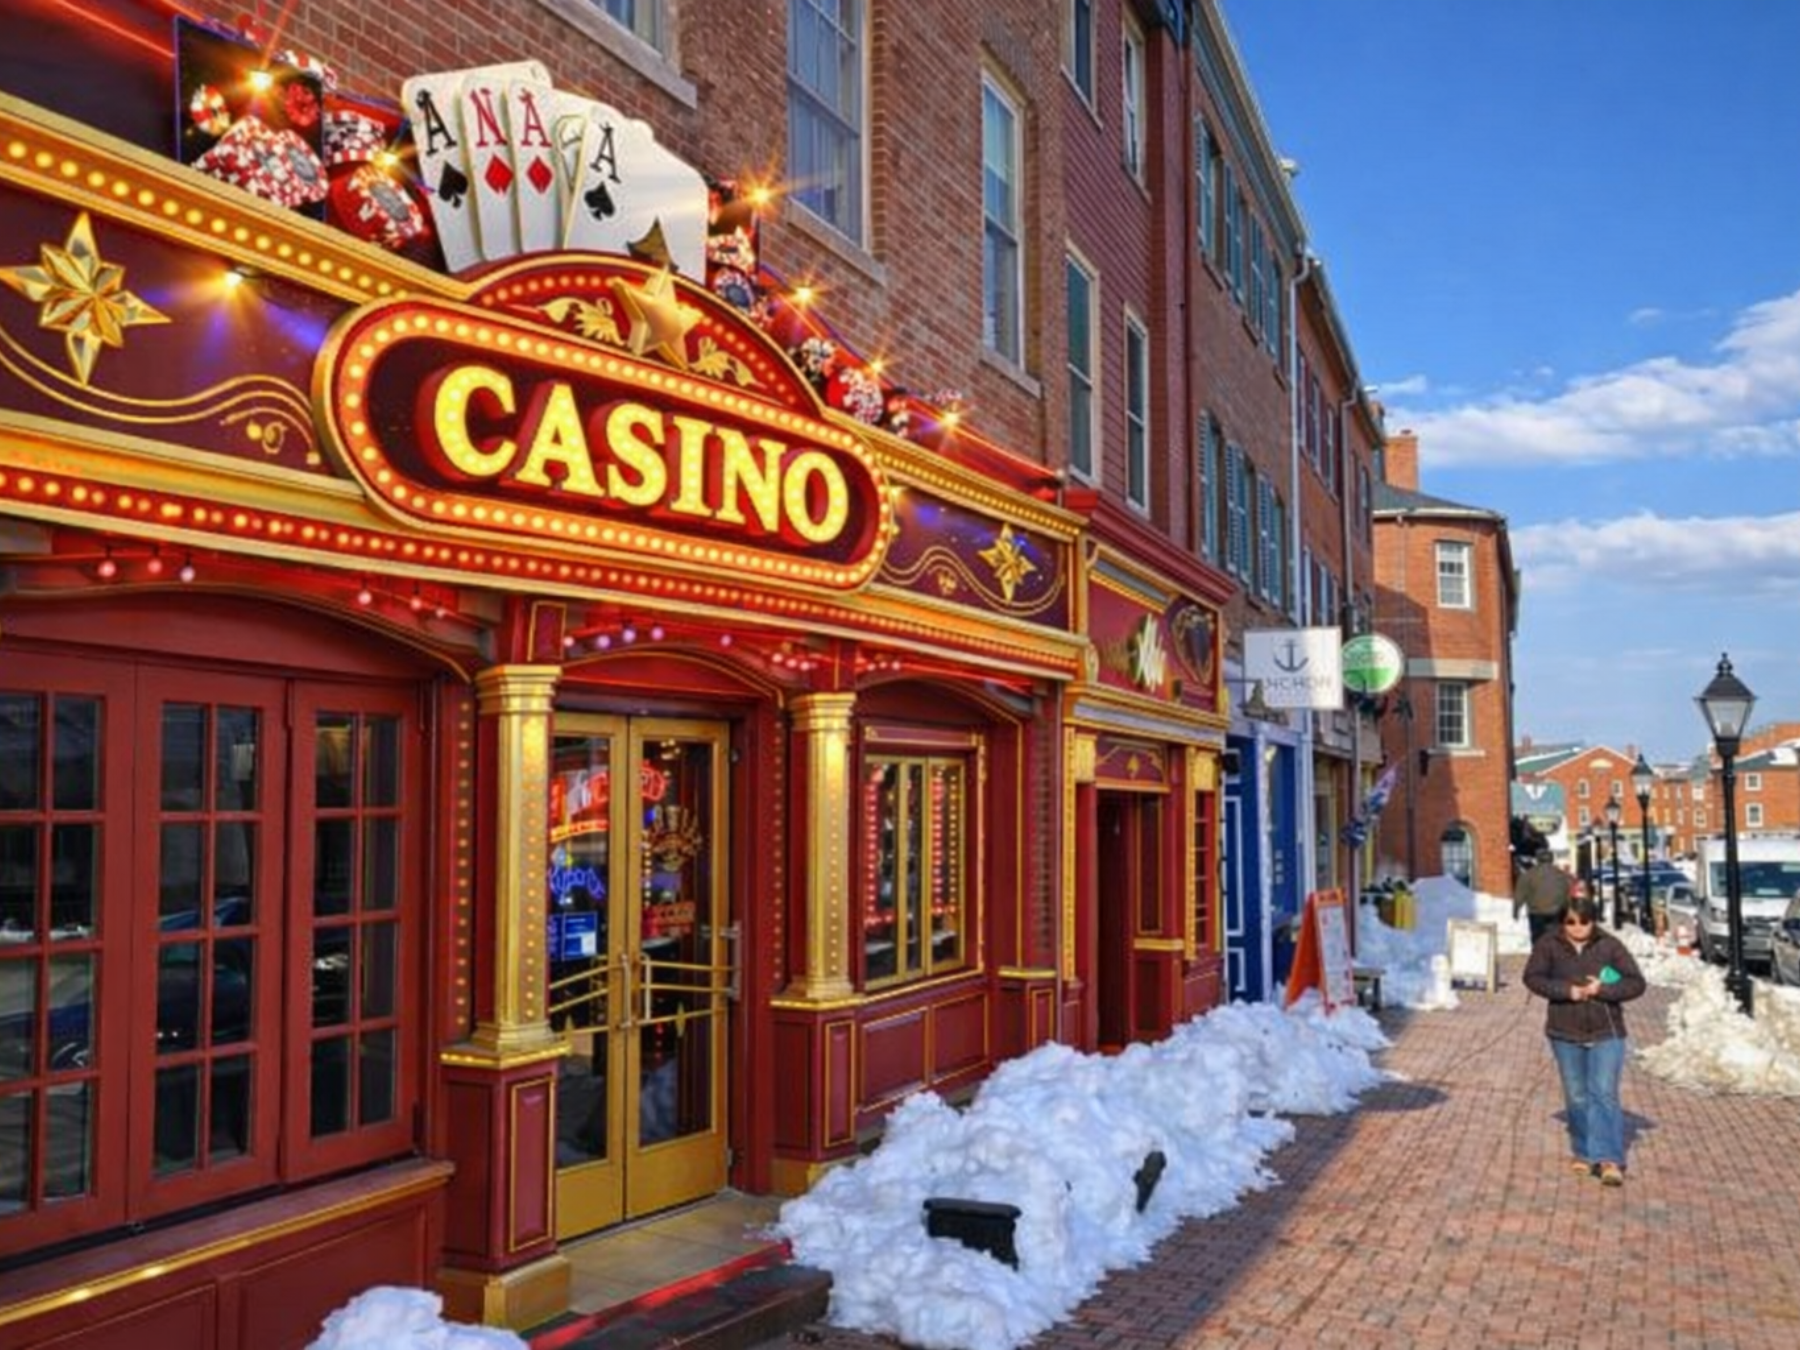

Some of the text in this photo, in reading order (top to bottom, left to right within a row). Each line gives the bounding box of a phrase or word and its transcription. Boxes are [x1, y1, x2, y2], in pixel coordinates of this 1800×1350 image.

[416, 89, 457, 156] A
[470, 87, 508, 147] N
[519, 87, 552, 147] A
[590, 121, 621, 184] A
[434, 365, 849, 543] CASINO
